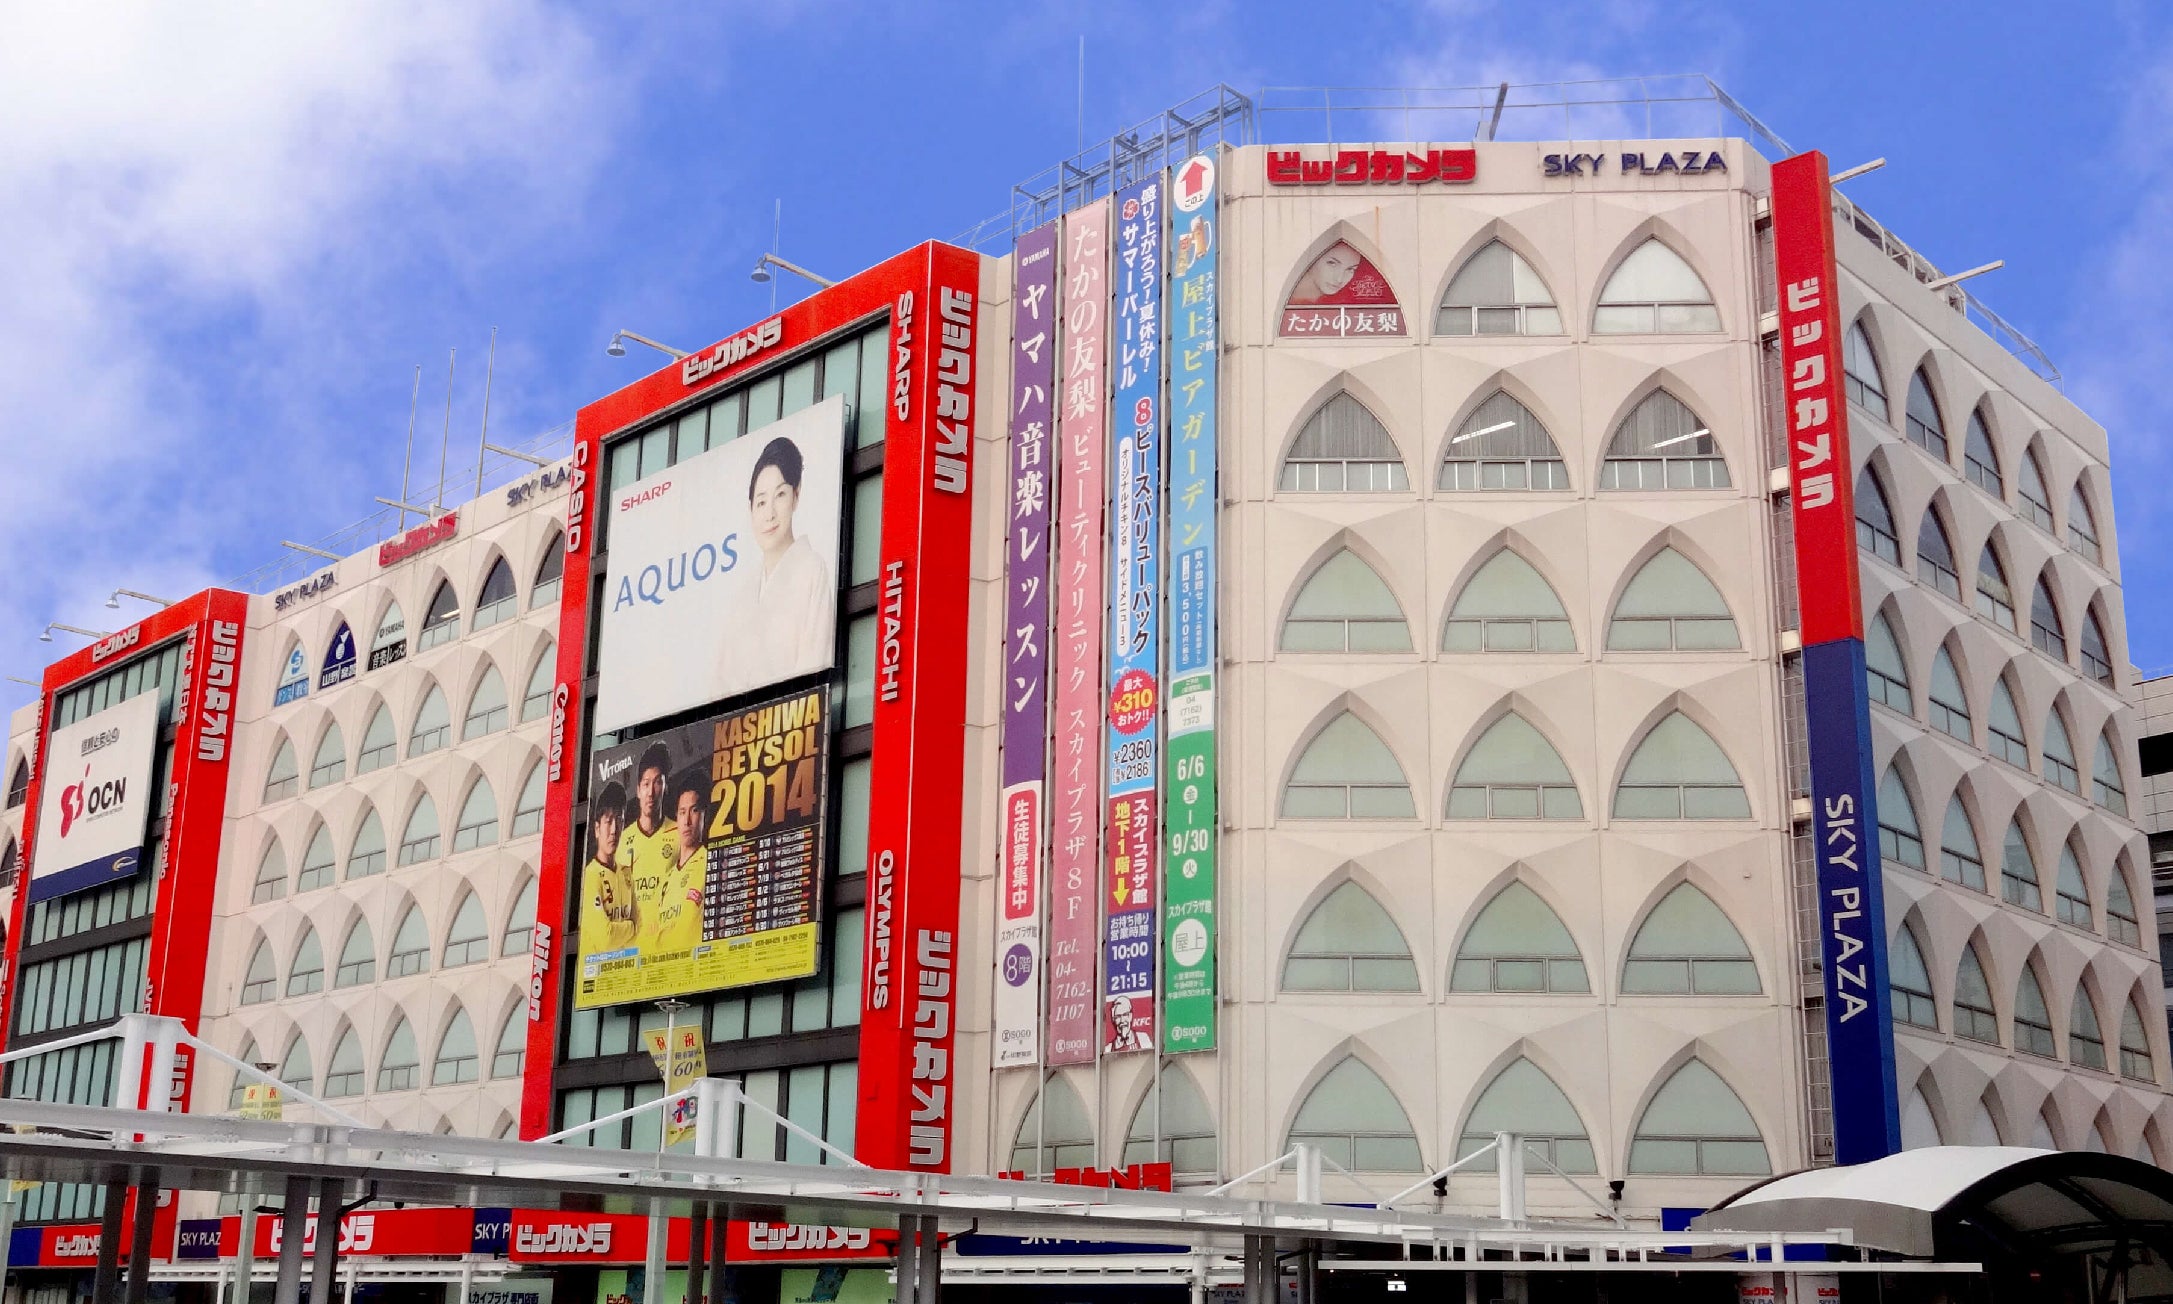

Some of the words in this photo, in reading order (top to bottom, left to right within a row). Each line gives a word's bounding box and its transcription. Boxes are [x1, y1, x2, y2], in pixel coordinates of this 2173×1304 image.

[1267, 149, 1476, 185] ビックカメラ
[1544, 152, 1605, 176] SKY
[1621, 151, 1727, 175] PLAZA
[1069, 225, 1099, 421] たかの友梨
[1120, 225, 1140, 390] サマーバーレル
[1287, 312, 1398, 333] たかの友梨
[682, 317, 782, 386] ビックカメラ
[895, 290, 914, 421] SHARP
[935, 286, 972, 494] ビックカメラ
[1787, 276, 1834, 509] ビックカメラ
[567, 440, 588, 553] CASIO
[621, 481, 672, 512] SHARP
[1013, 284, 1048, 713] ヤマハ音楽レッスン
[275, 589, 298, 610] SKY
[300, 572, 334, 599] PLAZA
[614, 533, 739, 613] AQUOS
[92, 625, 140, 663] ビックカメラ
[881, 561, 903, 701] HITACHI
[198, 620, 239, 761] ビックカメラ
[1113, 688, 1153, 713] ¥310
[1124, 677, 1143, 692] 最大
[549, 683, 568, 782] Canon
[714, 694, 820, 750] KASHIWA
[712, 726, 819, 781] REYSOL
[1114, 739, 1152, 764] ¥2360
[1177, 755, 1204, 781] 6/6
[88, 777, 126, 814] OCN
[708, 758, 817, 838] 2014
[160, 782, 178, 880] Panasonic
[1012, 799, 1030, 911] 生徒募集中
[1114, 801, 1131, 875] 地下1階
[1173, 830, 1208, 856] 9/30
[1825, 794, 1859, 872] SKY
[872, 849, 894, 1011] OLYMPUS
[1111, 925, 1149, 941] 営業時間
[1112, 942, 1148, 960] 10:00
[1175, 930, 1204, 953] 屋上
[1832, 887, 1868, 1023] PLAZA
[530, 922, 551, 1021] Nikon
[1006, 954, 1031, 982] 8階
[1111, 972, 1147, 991] 21:15
[909, 929, 951, 1165] ビックカメラ
[1132, 1017, 1150, 1026] KFC
[180, 1232, 197, 1246] SKY
[475, 1222, 500, 1240] SKY
[516, 1223, 613, 1254] ビックカメラ
